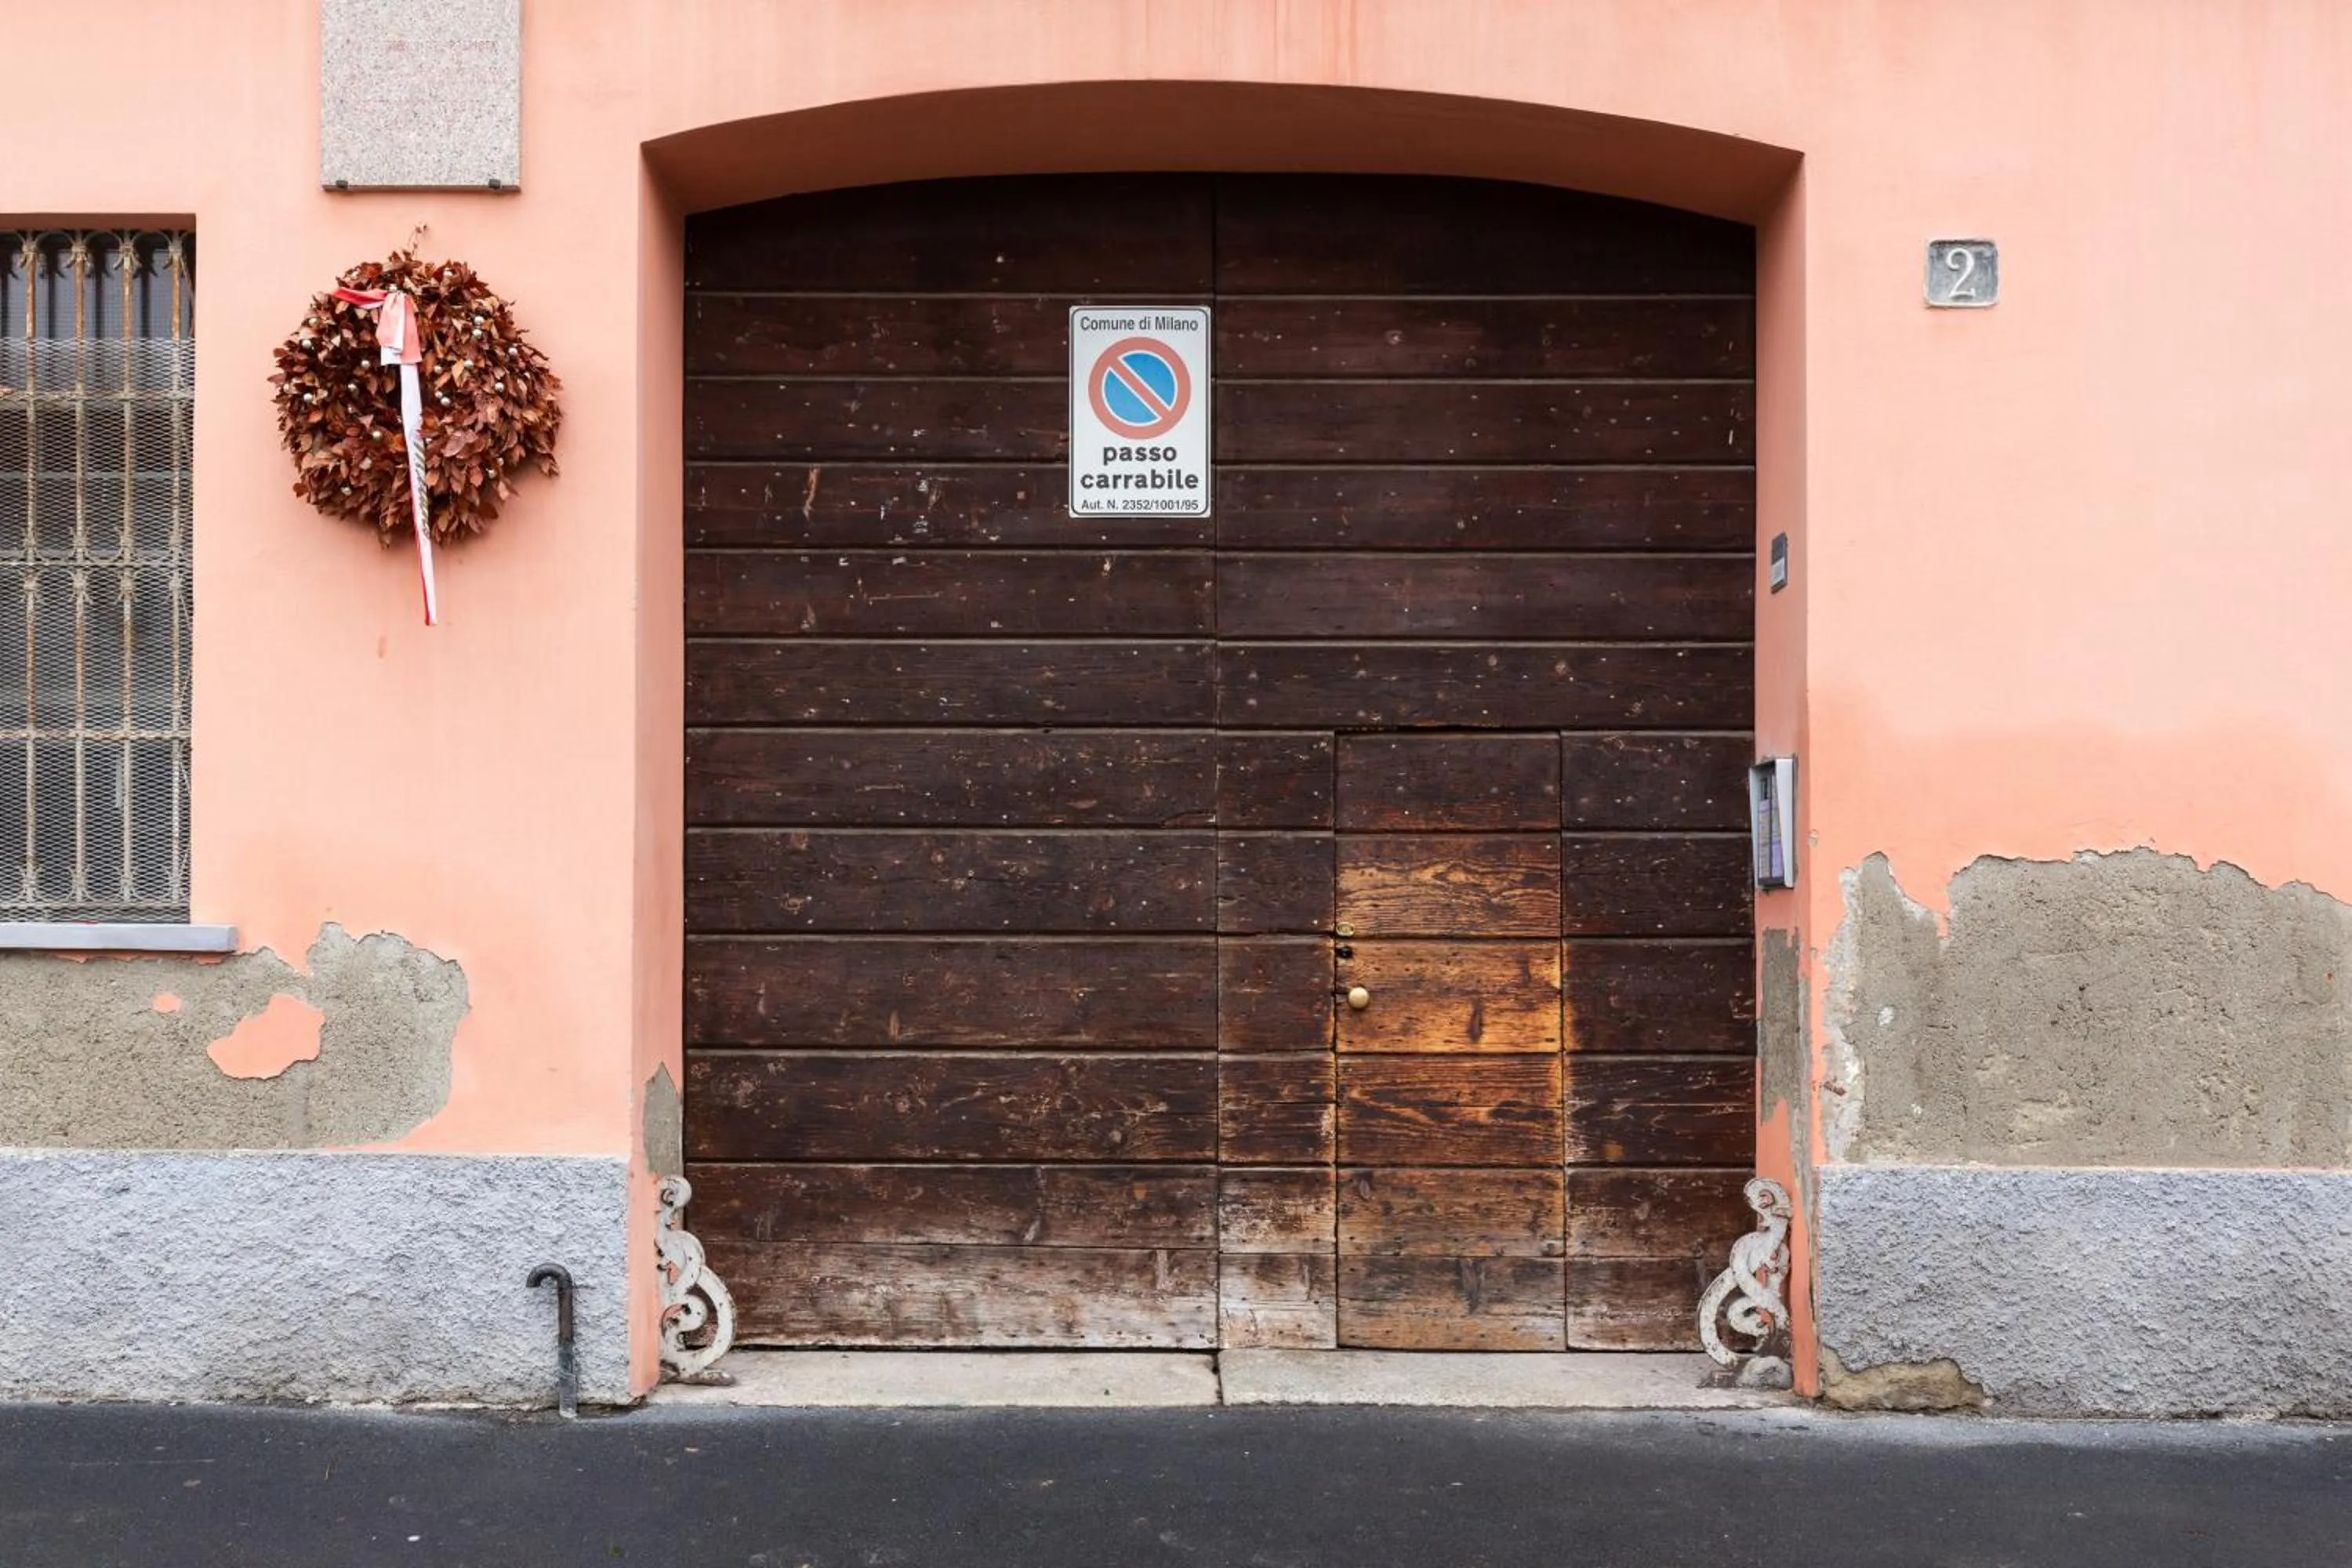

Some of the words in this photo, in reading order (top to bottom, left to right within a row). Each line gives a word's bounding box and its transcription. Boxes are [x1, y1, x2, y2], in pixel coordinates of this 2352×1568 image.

[1946, 248, 1975, 298] 2
[1080, 316, 1134, 330] Comune
[1139, 317, 1151, 330] di
[1155, 317, 1198, 331] Milano
[1102, 446, 1177, 466] passo
[1080, 469, 1199, 489] carrabile
[1081, 499, 1103, 510] Aut.
[1106, 499, 1119, 510] N.
[1122, 499, 1199, 510] 2352/1001/95
